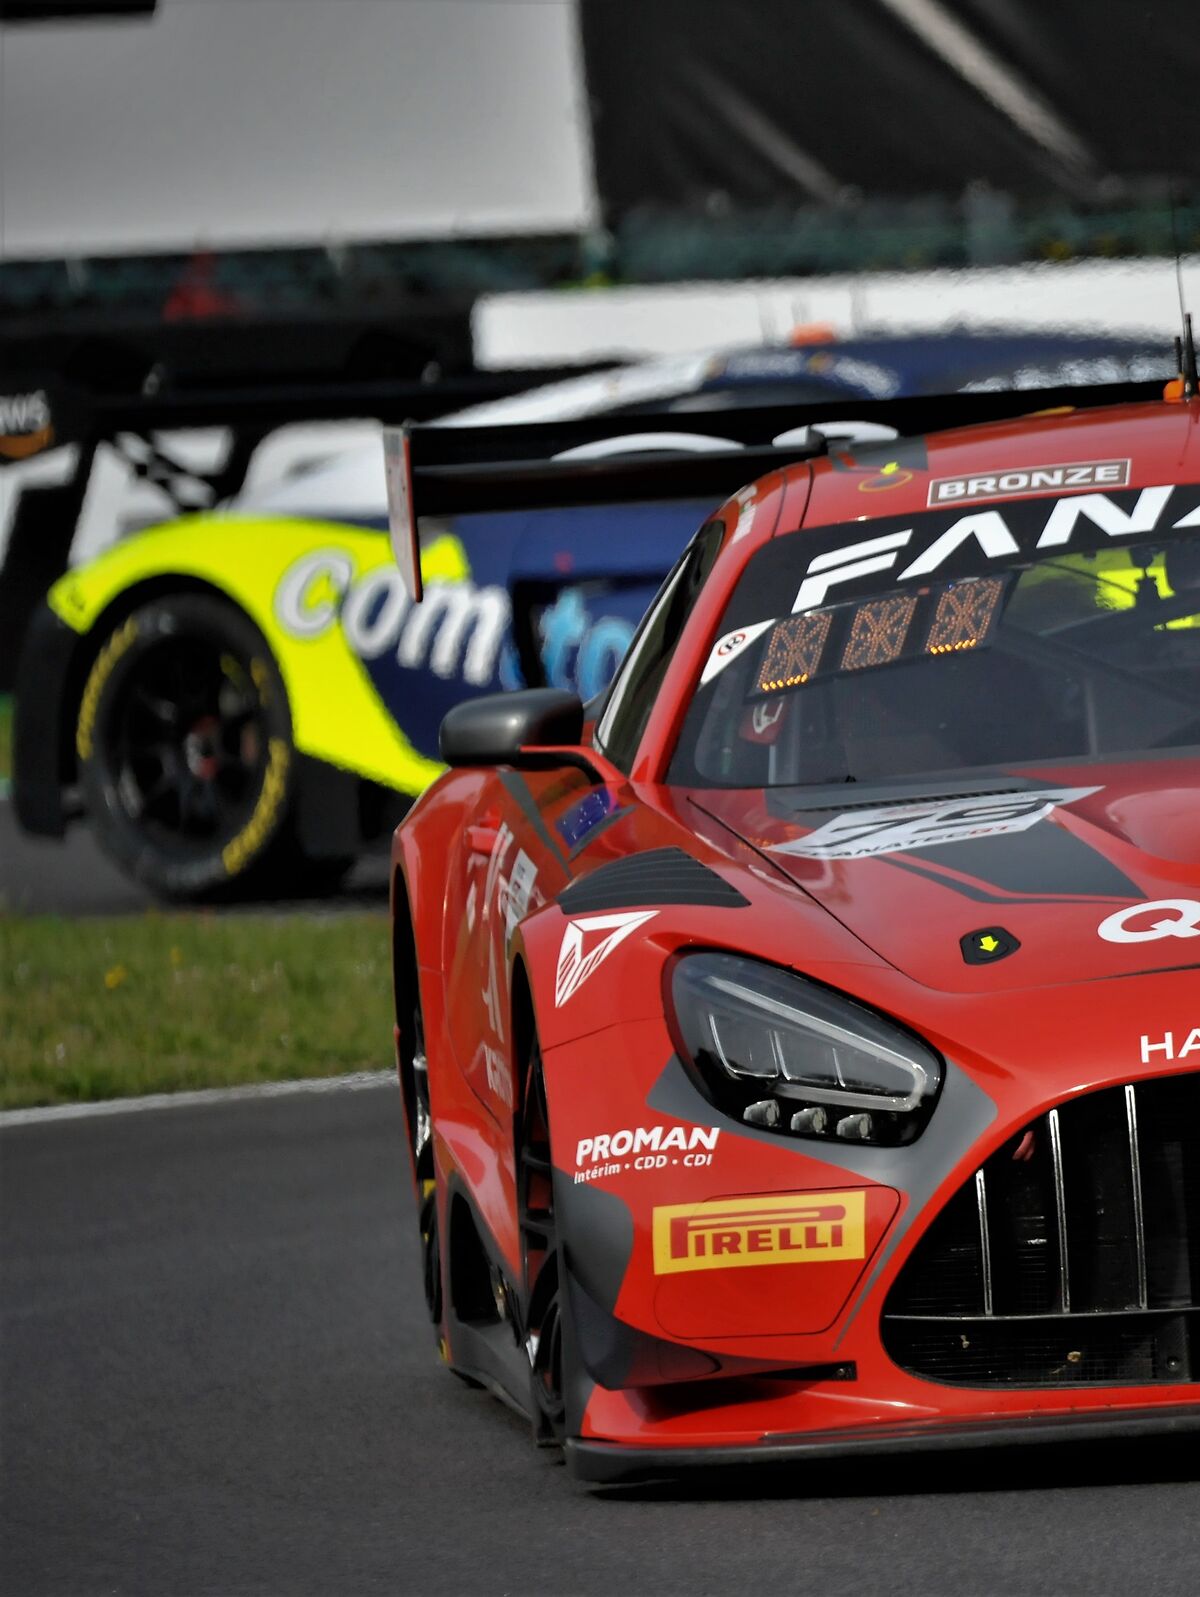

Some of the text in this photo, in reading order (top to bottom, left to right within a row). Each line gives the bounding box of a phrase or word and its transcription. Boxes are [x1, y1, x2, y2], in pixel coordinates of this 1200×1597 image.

[937, 464, 1122, 501] BRONZE
[575, 1126, 721, 1167] PROMAN
[573, 1153, 713, 1184] Intérim CDD CDI
[669, 1204, 847, 1260] PIRELLI
